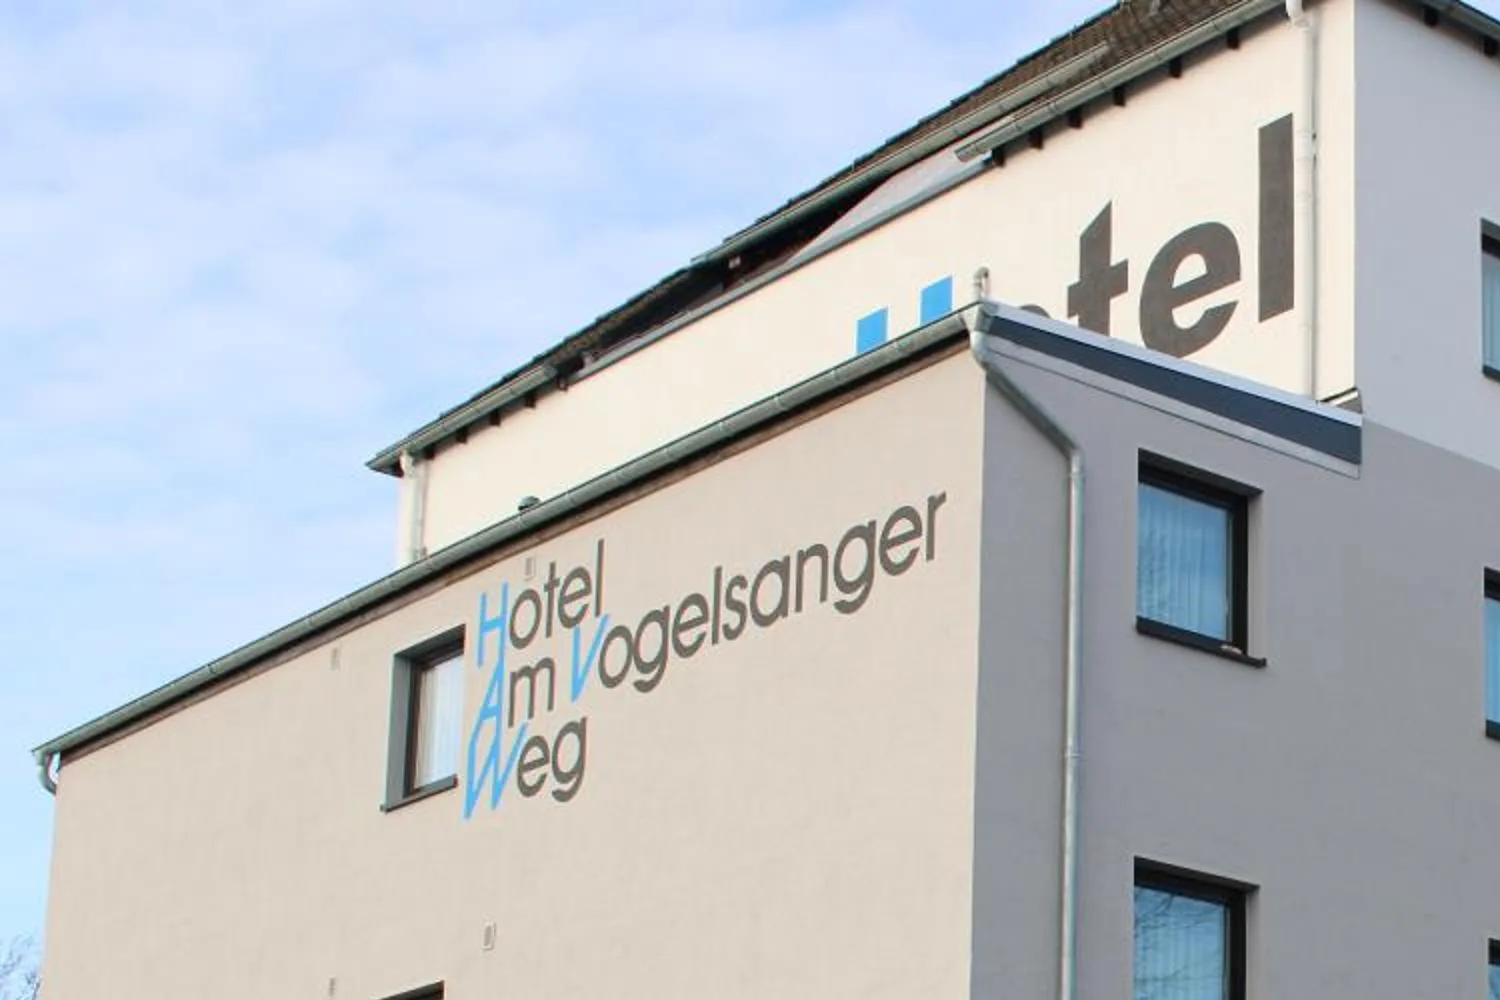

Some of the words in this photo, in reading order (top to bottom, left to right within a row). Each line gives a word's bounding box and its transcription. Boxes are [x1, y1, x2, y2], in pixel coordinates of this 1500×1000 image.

[855, 112, 1295, 359] tel
[469, 655, 555, 740] Am
[571, 491, 947, 703] Vogelsanger
[476, 538, 605, 668] Hotel
[463, 716, 588, 820] Weg
